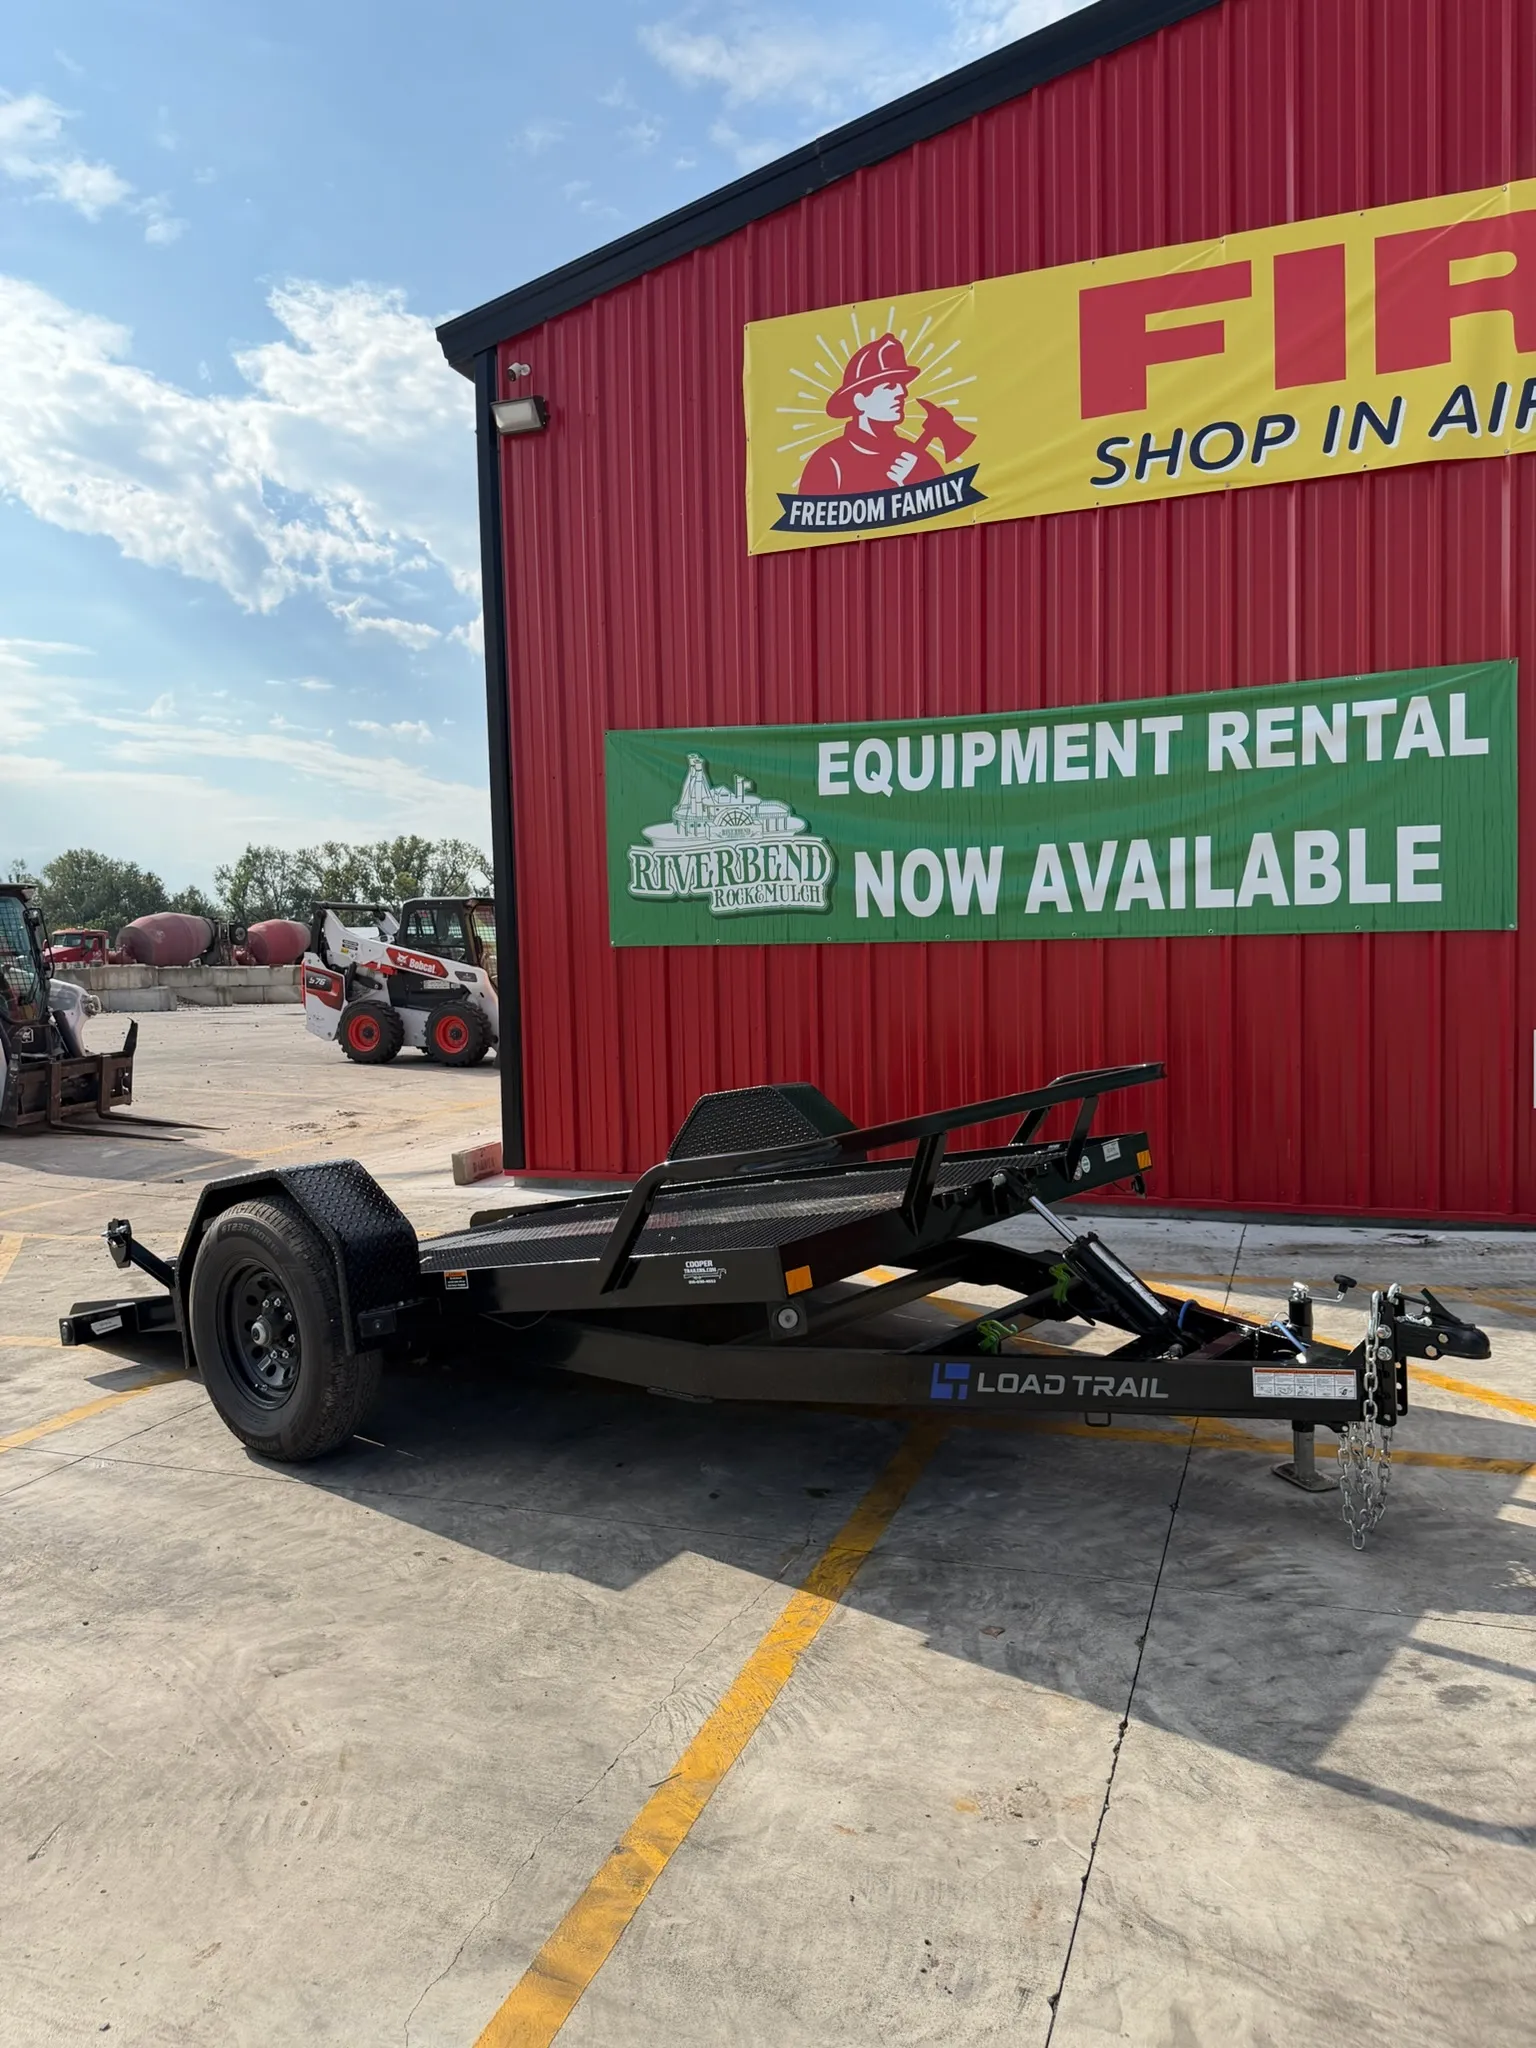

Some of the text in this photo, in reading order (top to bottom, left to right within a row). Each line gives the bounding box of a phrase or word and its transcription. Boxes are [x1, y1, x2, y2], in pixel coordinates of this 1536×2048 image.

[1079, 209, 1536, 420] FIR
[1090, 413, 1299, 488] SHOP
[1322, 396, 1406, 456] IN
[789, 477, 964, 526] FREEDOM FAMILY
[818, 693, 1489, 798] EQUIPMENT RENTAL
[631, 843, 828, 893] RIVERBEND
[854, 825, 1442, 918] NOW AVAILABLE
[408, 959, 437, 974] Bobcat
[685, 1260, 713, 1268] COOPER
[977, 1372, 1169, 1398] LOAD TRAIL
